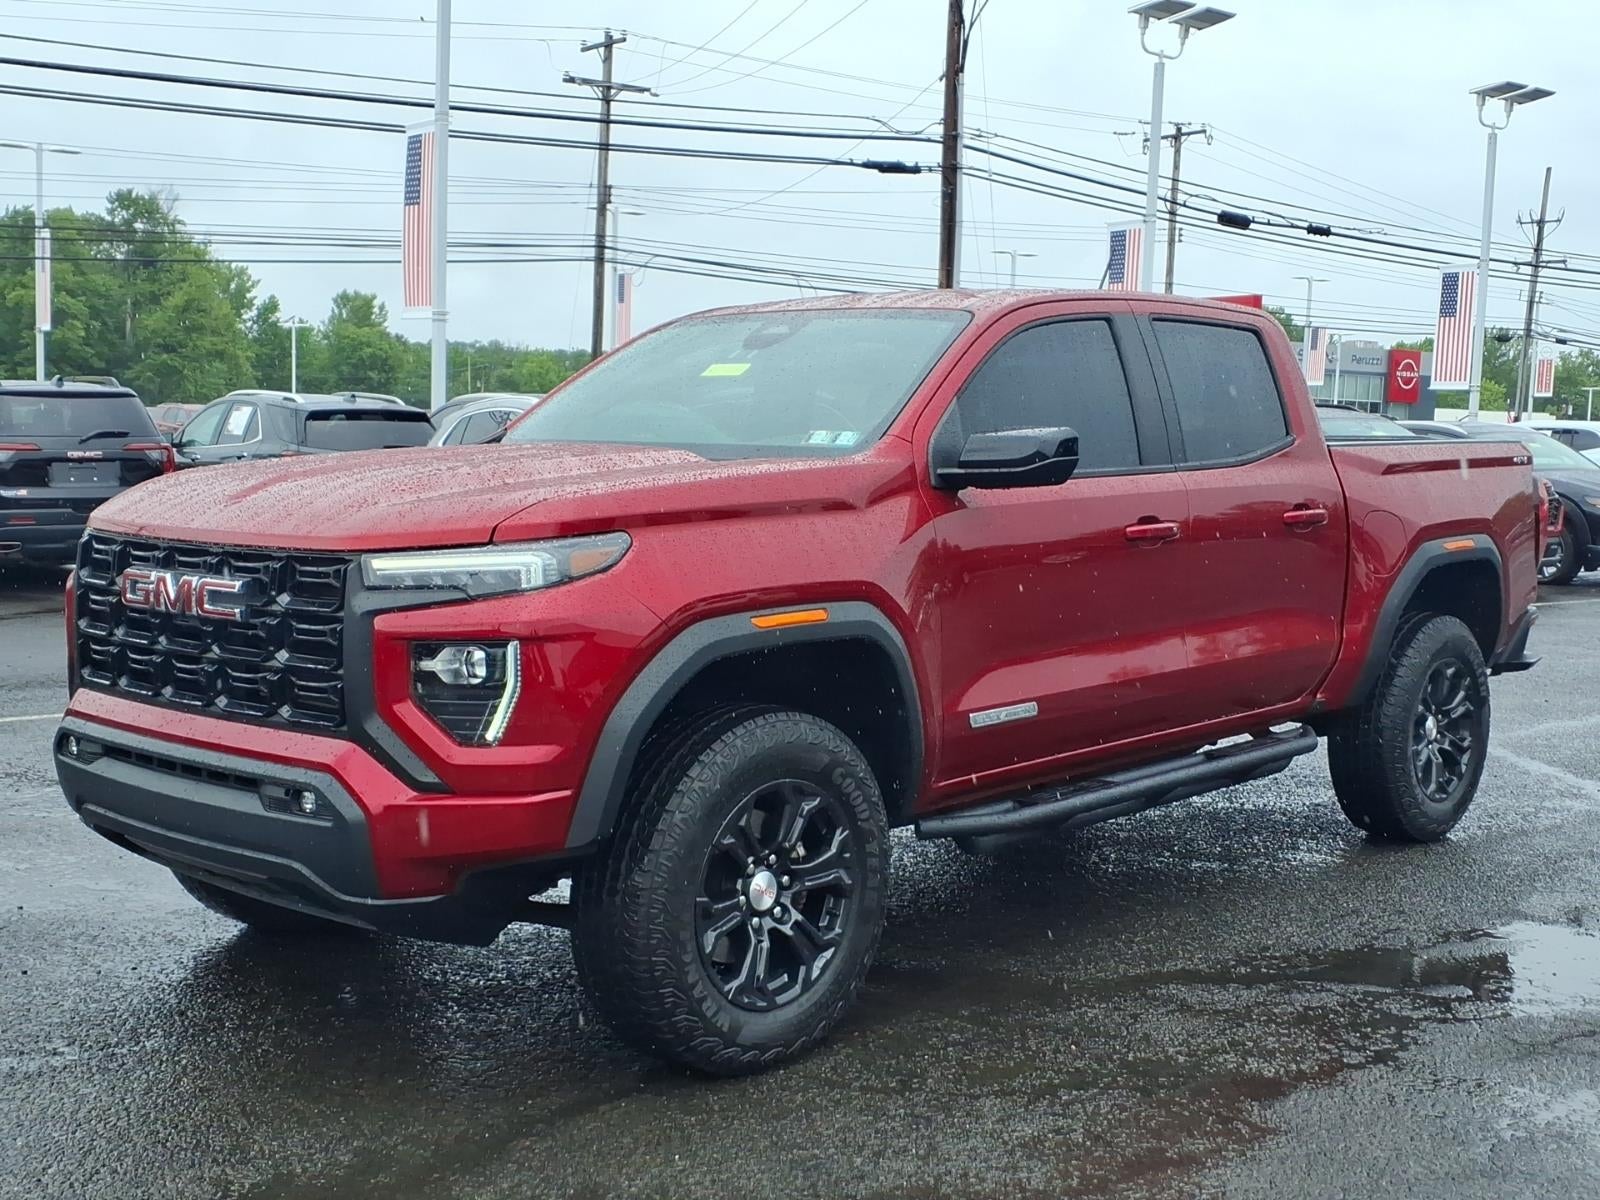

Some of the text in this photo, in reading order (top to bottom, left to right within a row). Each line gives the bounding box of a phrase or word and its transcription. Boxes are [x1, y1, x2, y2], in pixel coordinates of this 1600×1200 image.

[1351, 354, 1383, 366] Peruzzi
[1396, 370, 1419, 378] NISSAN
[67, 450, 103, 459] GMC
[121, 568, 243, 621] GMC
